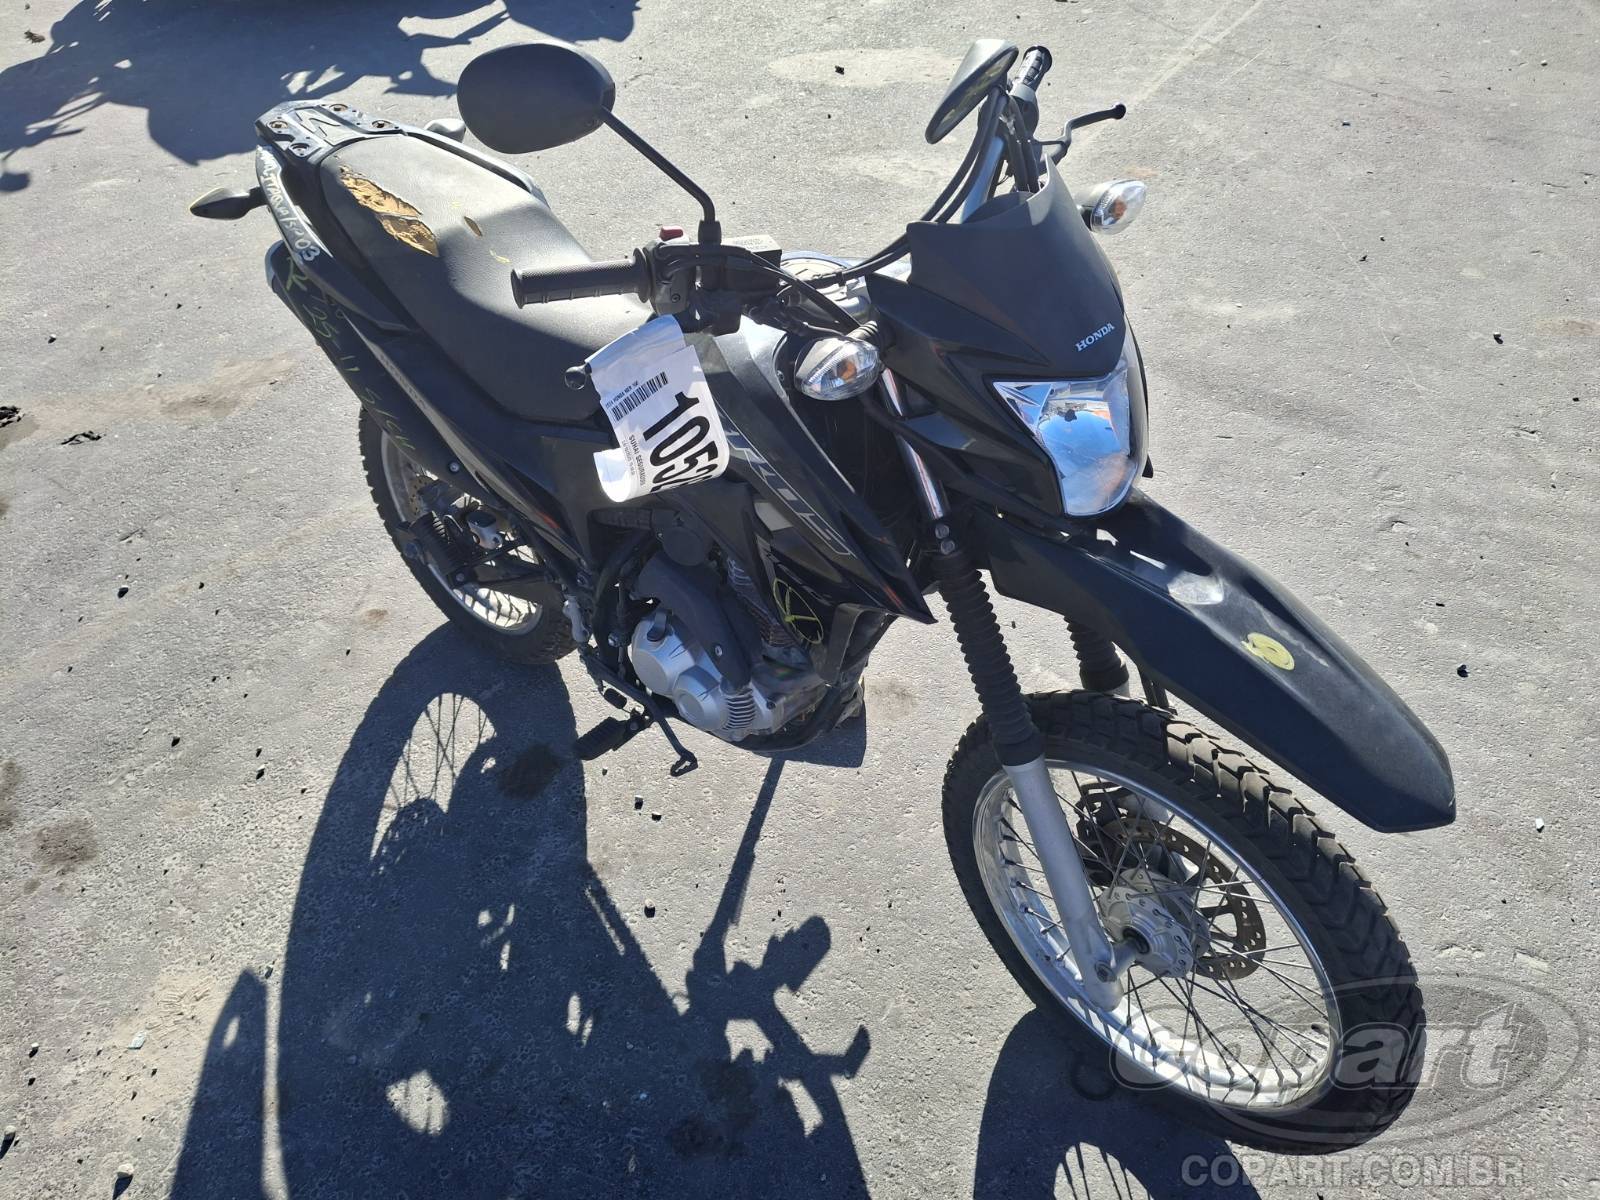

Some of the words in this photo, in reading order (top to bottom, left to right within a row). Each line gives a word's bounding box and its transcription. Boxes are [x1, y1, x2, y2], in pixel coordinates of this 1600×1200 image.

[294, 238, 321, 262] 03
[1075, 322, 1116, 352] HONDA
[642, 391, 720, 493] 1052
